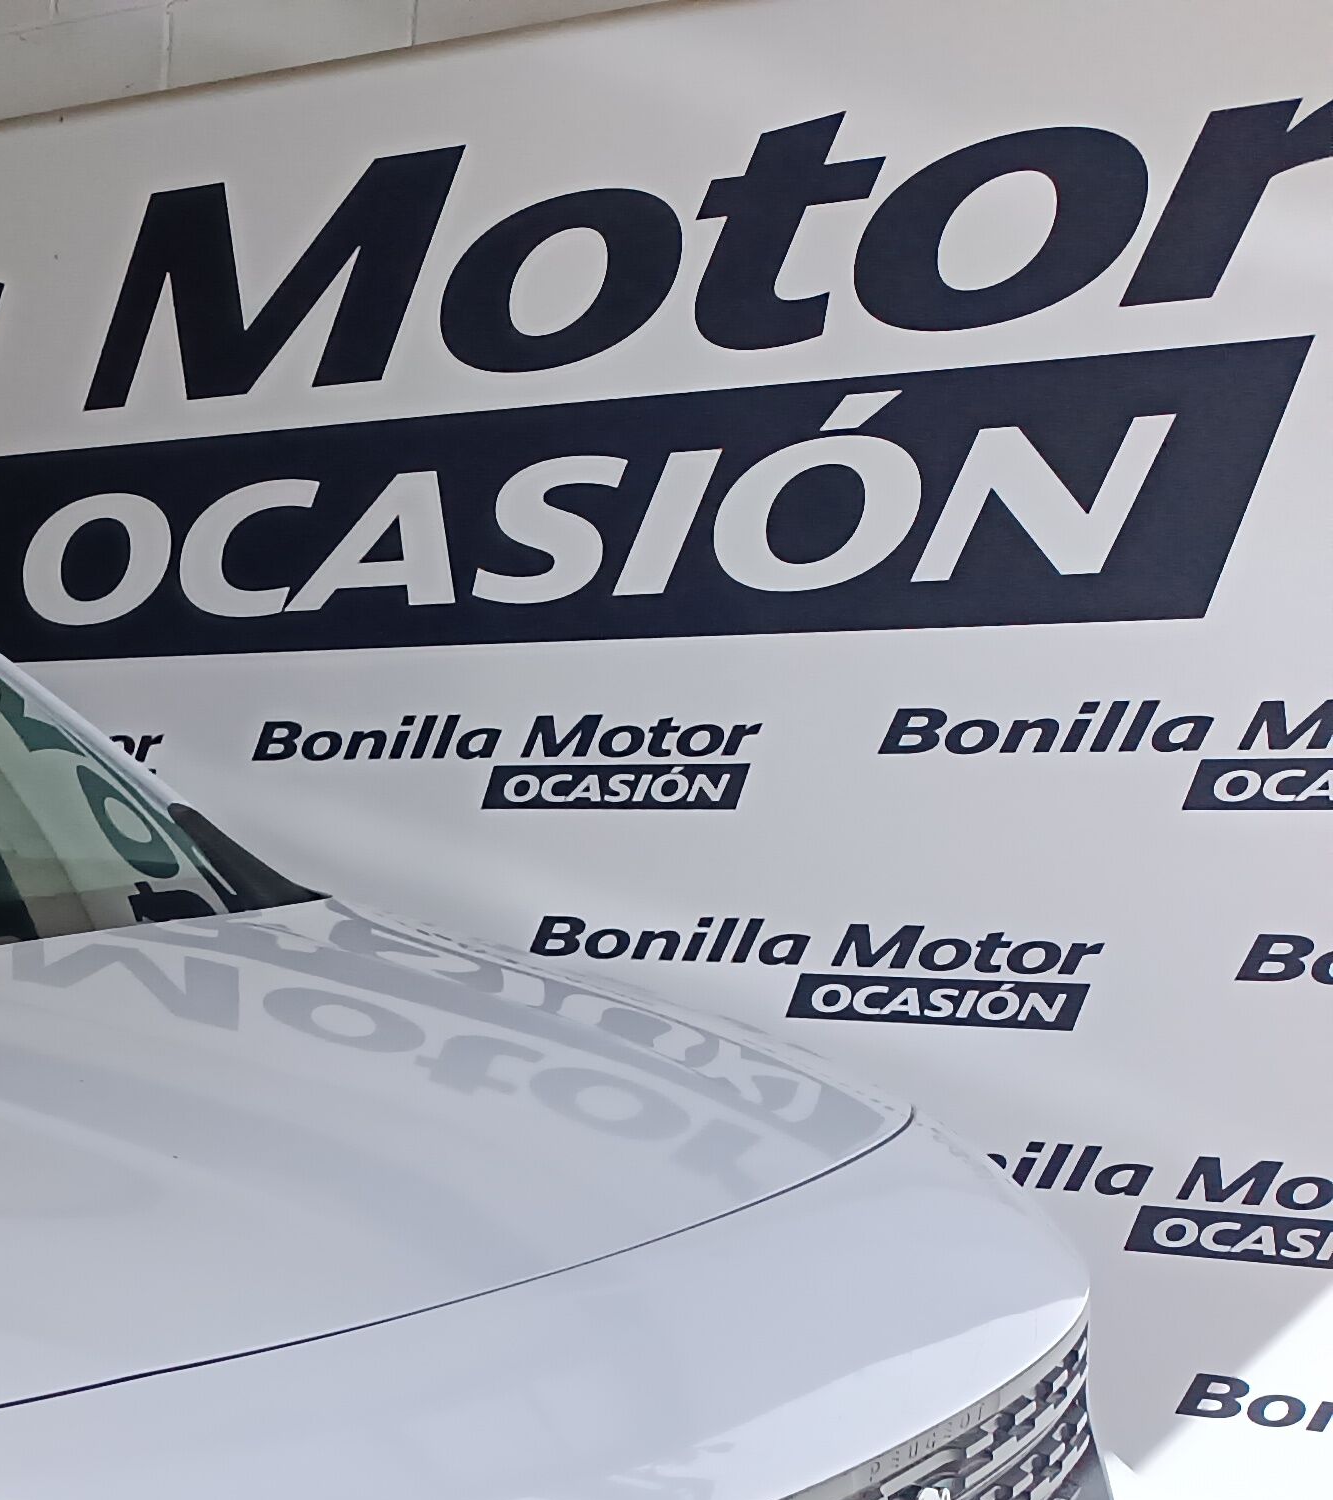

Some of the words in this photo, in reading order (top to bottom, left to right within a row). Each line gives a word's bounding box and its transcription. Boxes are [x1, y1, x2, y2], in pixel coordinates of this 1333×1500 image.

[83, 97, 1333, 411] Motor
[23, 389, 1177, 626] OCASIÓN
[252, 714, 502, 761] Bonilla
[521, 714, 763, 759] Motor
[878, 700, 1214, 755] Bonilla
[503, 767, 731, 803] OCASIÓN
[530, 915, 811, 965] Bonilla
[832, 923, 1105, 975] Motor
[811, 983, 1067, 1023] OCASIÓN
